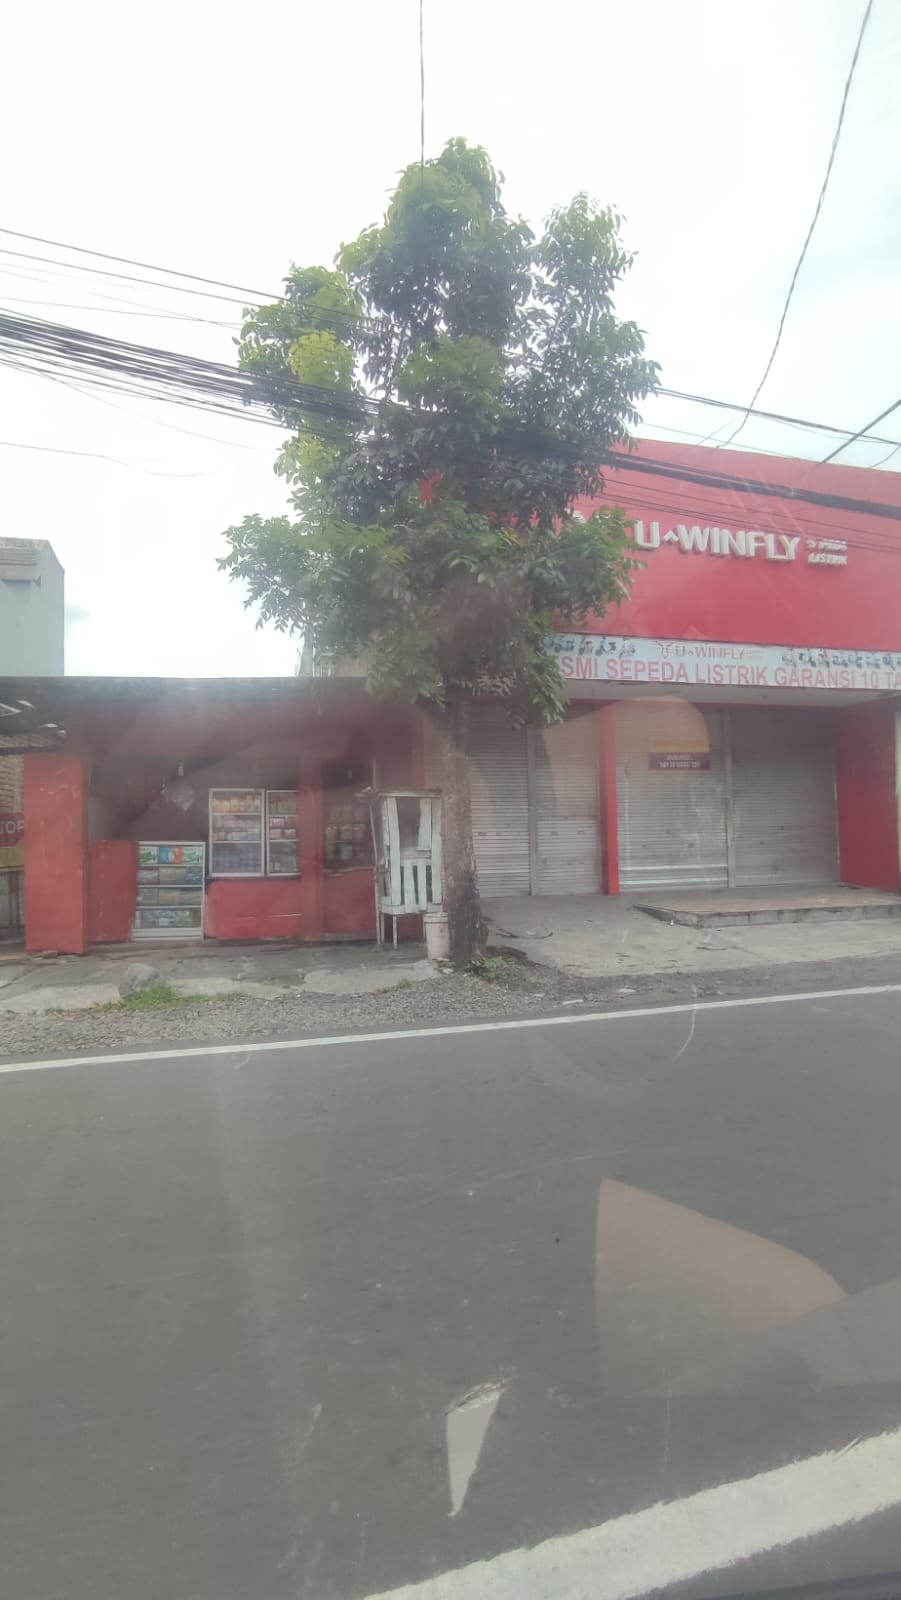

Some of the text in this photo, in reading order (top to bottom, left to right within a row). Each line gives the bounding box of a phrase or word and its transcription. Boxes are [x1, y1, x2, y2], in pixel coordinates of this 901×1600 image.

[560, 655, 597, 679] SMI
[606, 658, 688, 682] SEPEDA
[695, 664, 767, 686] LISTRIK
[774, 667, 855, 689] GARANSI
[861, 671, 878, 689] 10
